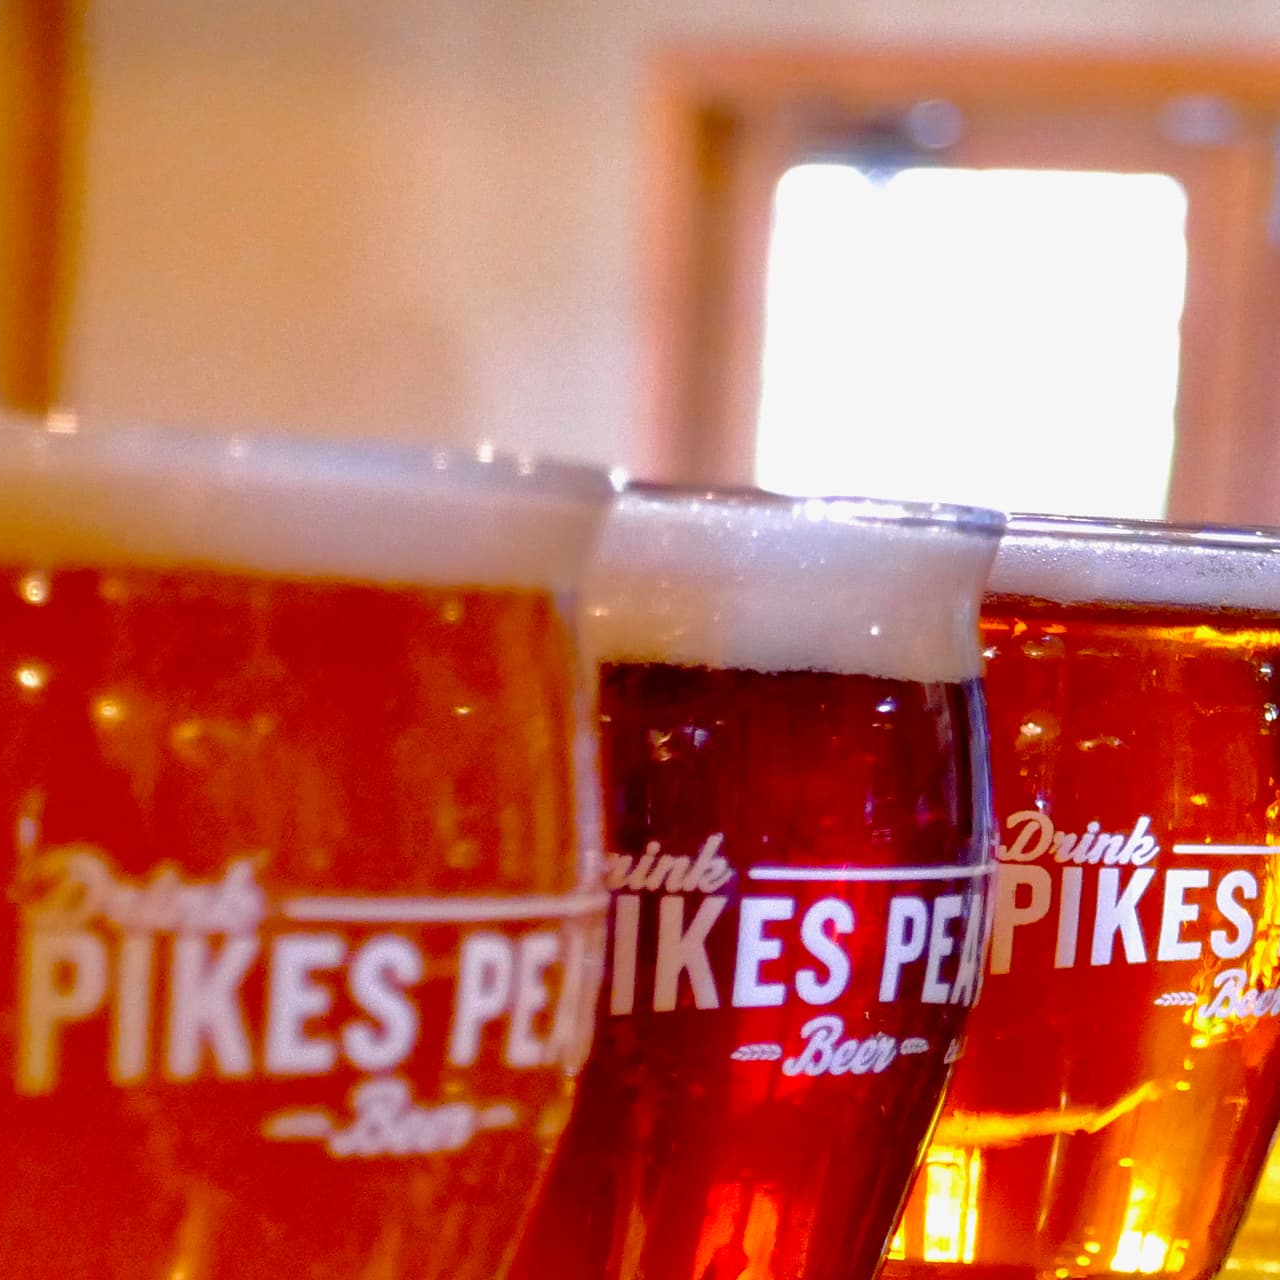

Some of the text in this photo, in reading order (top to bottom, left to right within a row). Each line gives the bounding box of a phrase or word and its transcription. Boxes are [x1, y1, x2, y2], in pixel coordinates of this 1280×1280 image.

[606, 832, 732, 891] rink
[998, 810, 1160, 866] Drink
[609, 892, 855, 1016] IKES
[988, 862, 1258, 976] PIKES
[19, 930, 425, 1097] PIKES
[781, 1014, 897, 1077] Beer
